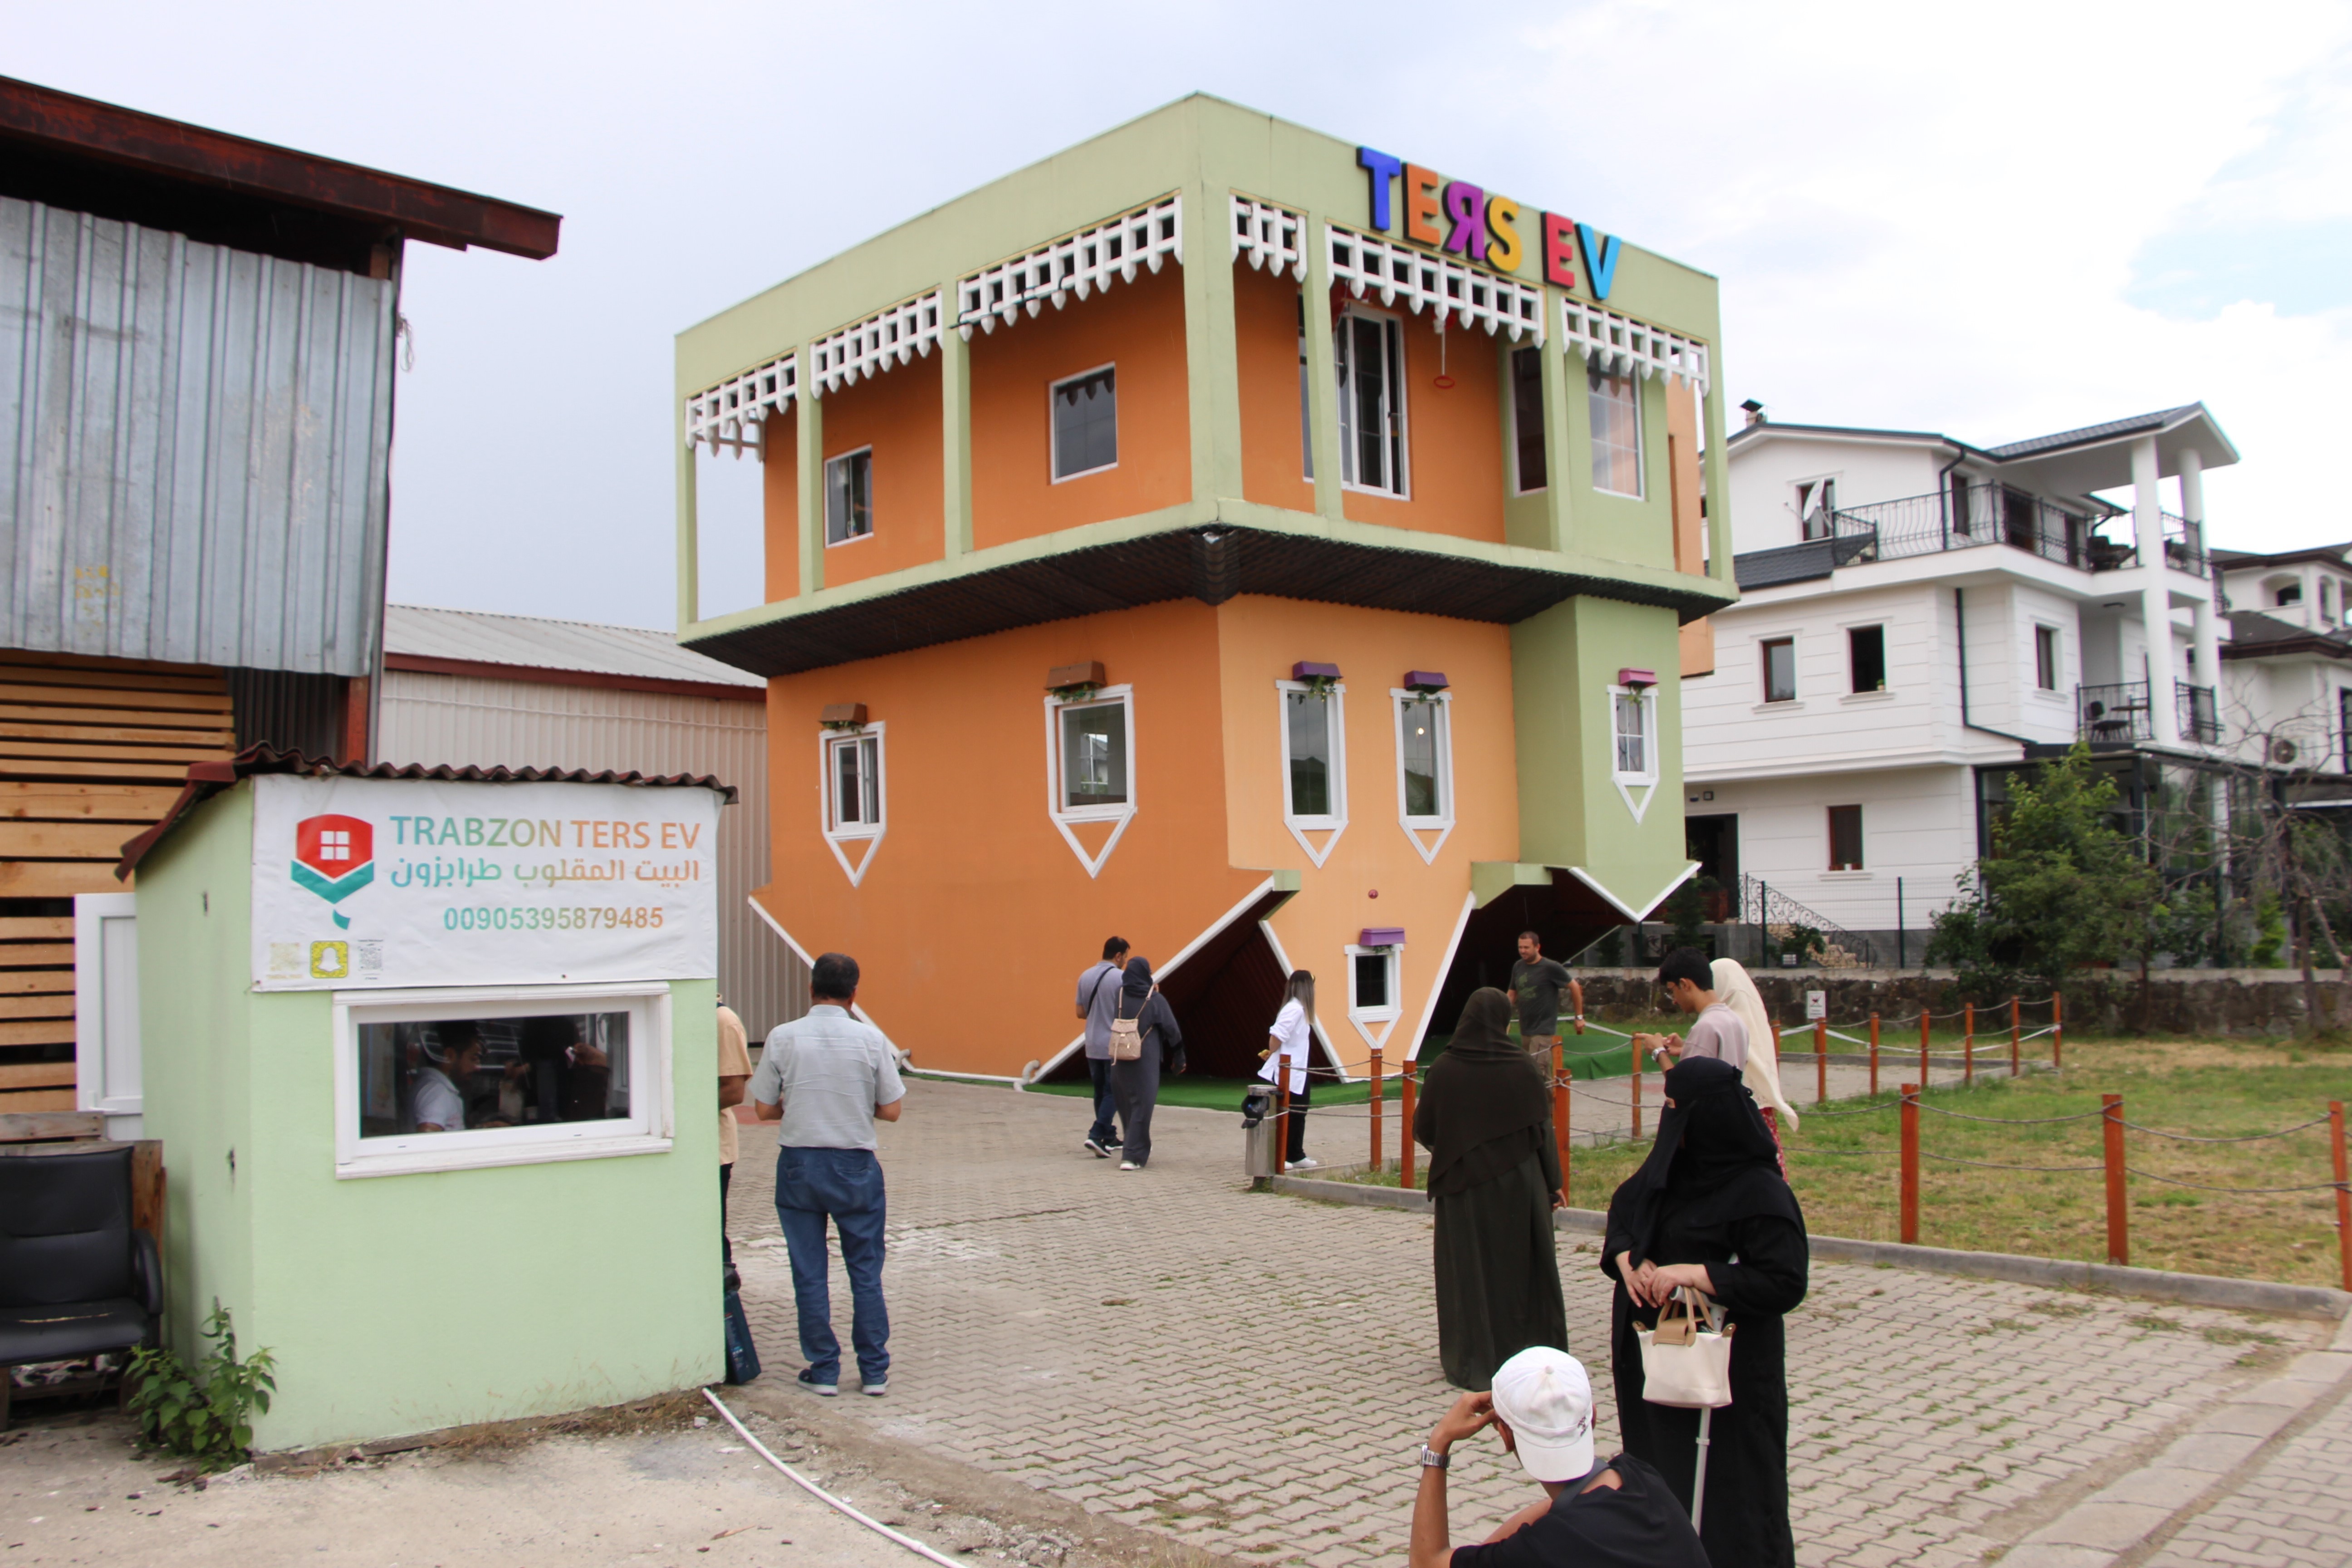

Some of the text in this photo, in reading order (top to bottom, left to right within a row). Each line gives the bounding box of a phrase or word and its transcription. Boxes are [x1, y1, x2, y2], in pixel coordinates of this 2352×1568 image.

[1541, 210, 1622, 301] EV
[389, 816, 701, 849] TRABZON TERS EV
[390, 856, 699, 888] البيت المقلوب طرابزون
[443, 907, 664, 930] 00905395879485
